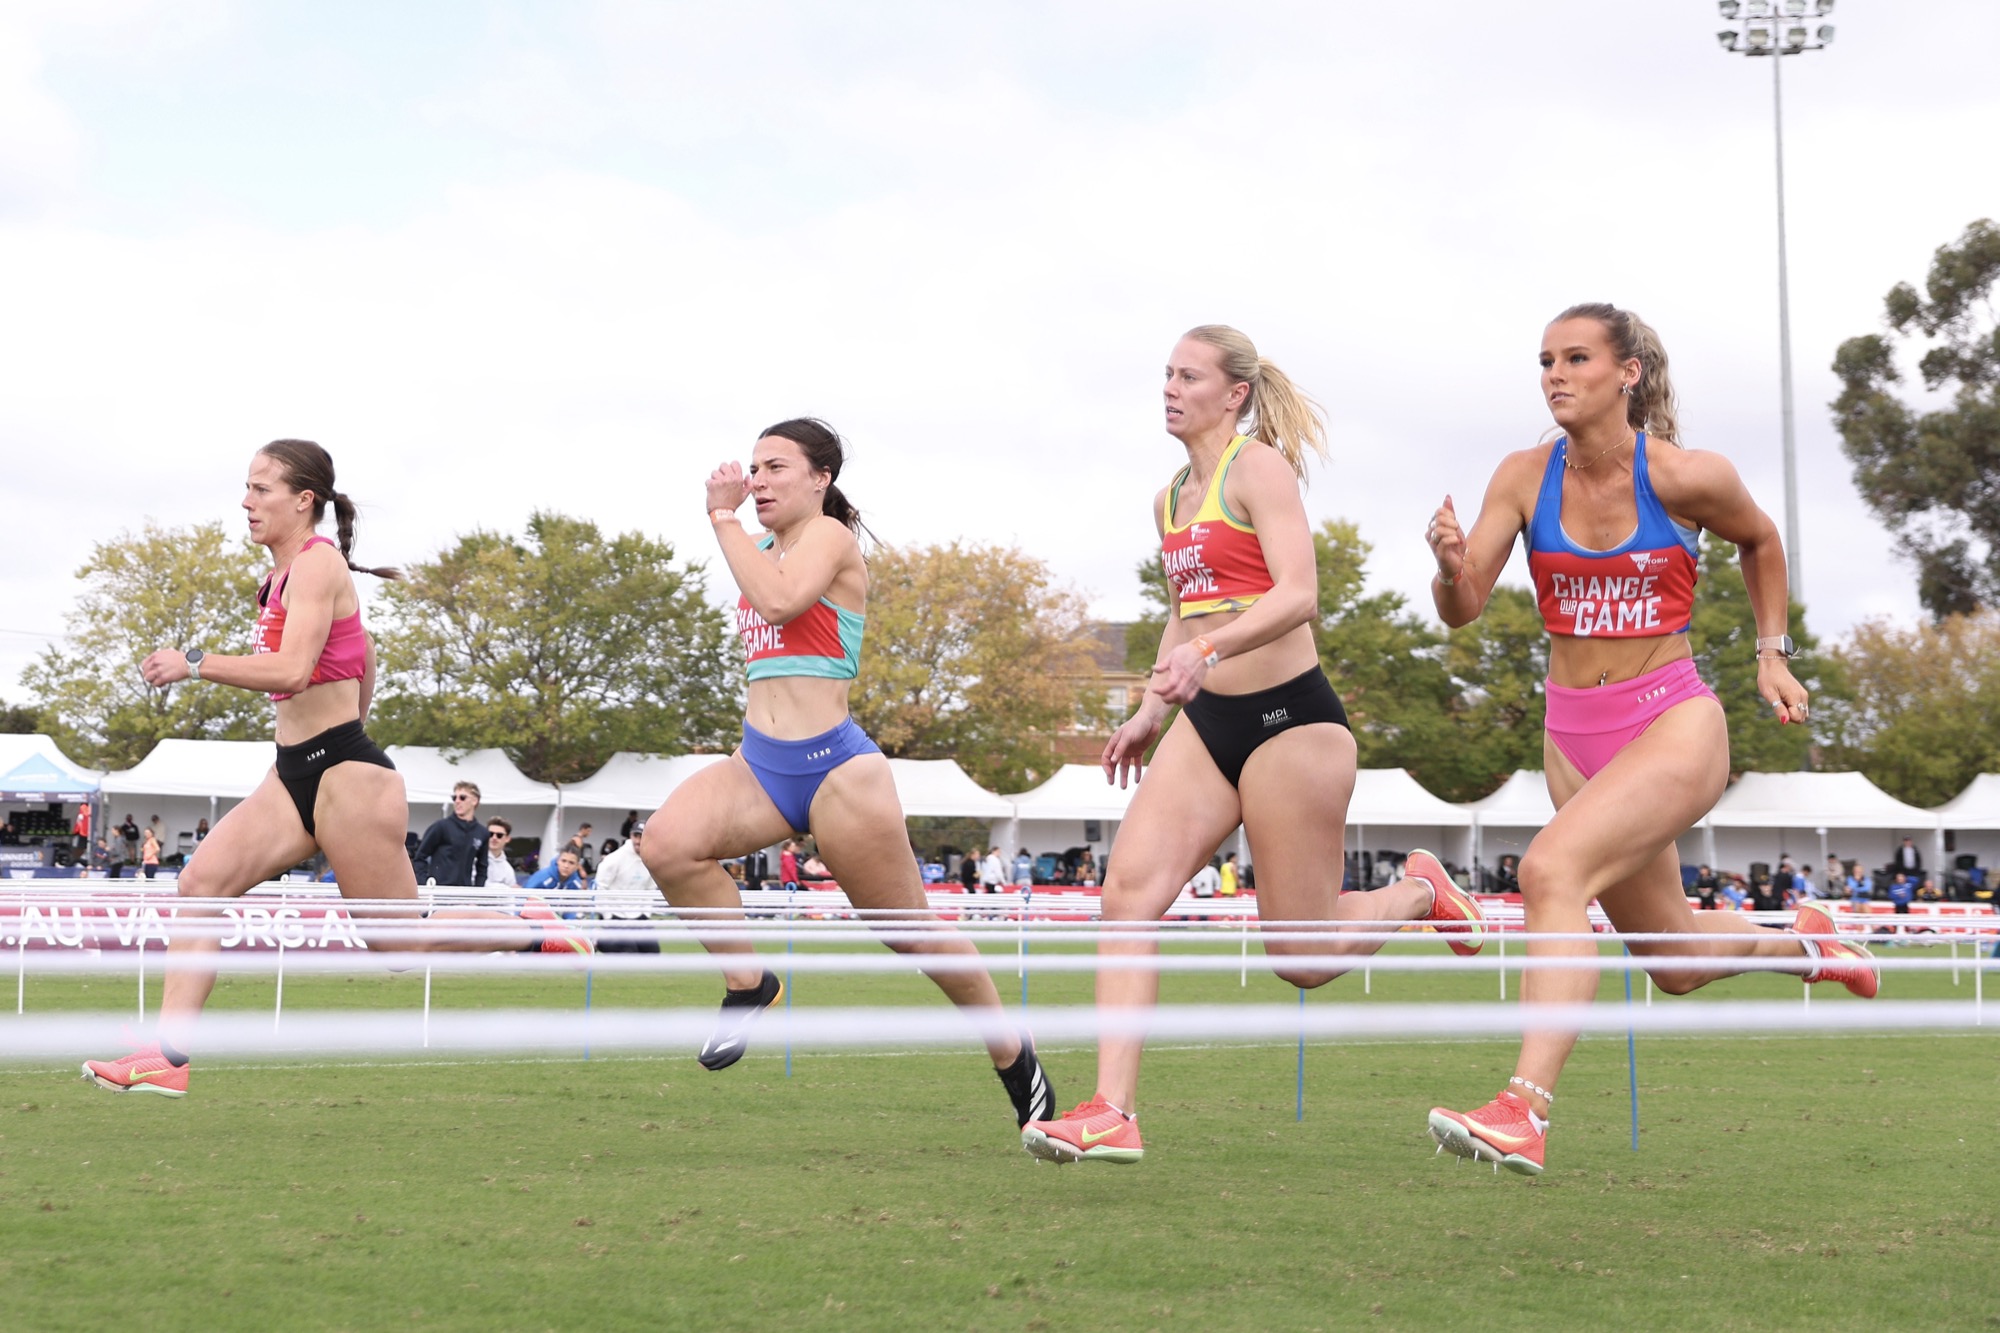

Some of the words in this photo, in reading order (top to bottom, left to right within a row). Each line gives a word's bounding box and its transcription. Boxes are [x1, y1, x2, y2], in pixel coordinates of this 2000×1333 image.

[1551, 573, 1659, 600] CHANGE
[1560, 599, 1578, 613] OUR
[1573, 596, 1662, 636] GAME
[1262, 707, 1287, 722] IMPI
